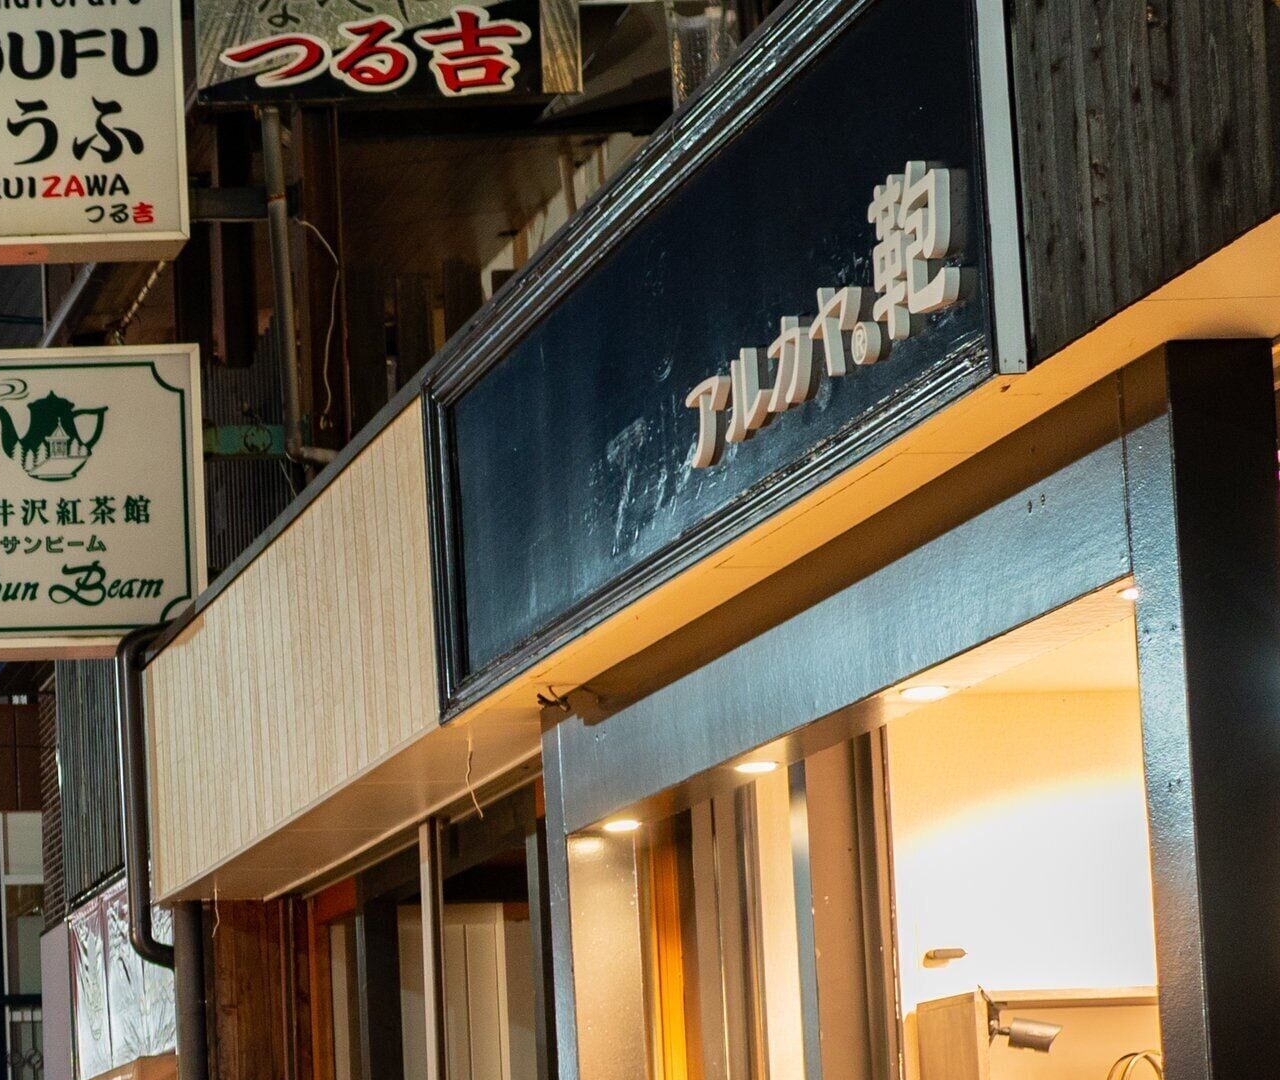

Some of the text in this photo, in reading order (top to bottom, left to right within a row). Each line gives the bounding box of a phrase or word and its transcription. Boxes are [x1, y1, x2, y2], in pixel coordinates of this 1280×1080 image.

[221, 7, 531, 97] つる吉
[84, 201, 155, 224] つる吉
[0, 534, 107, 555] サンビーム
[47, 560, 165, 607] Beam
